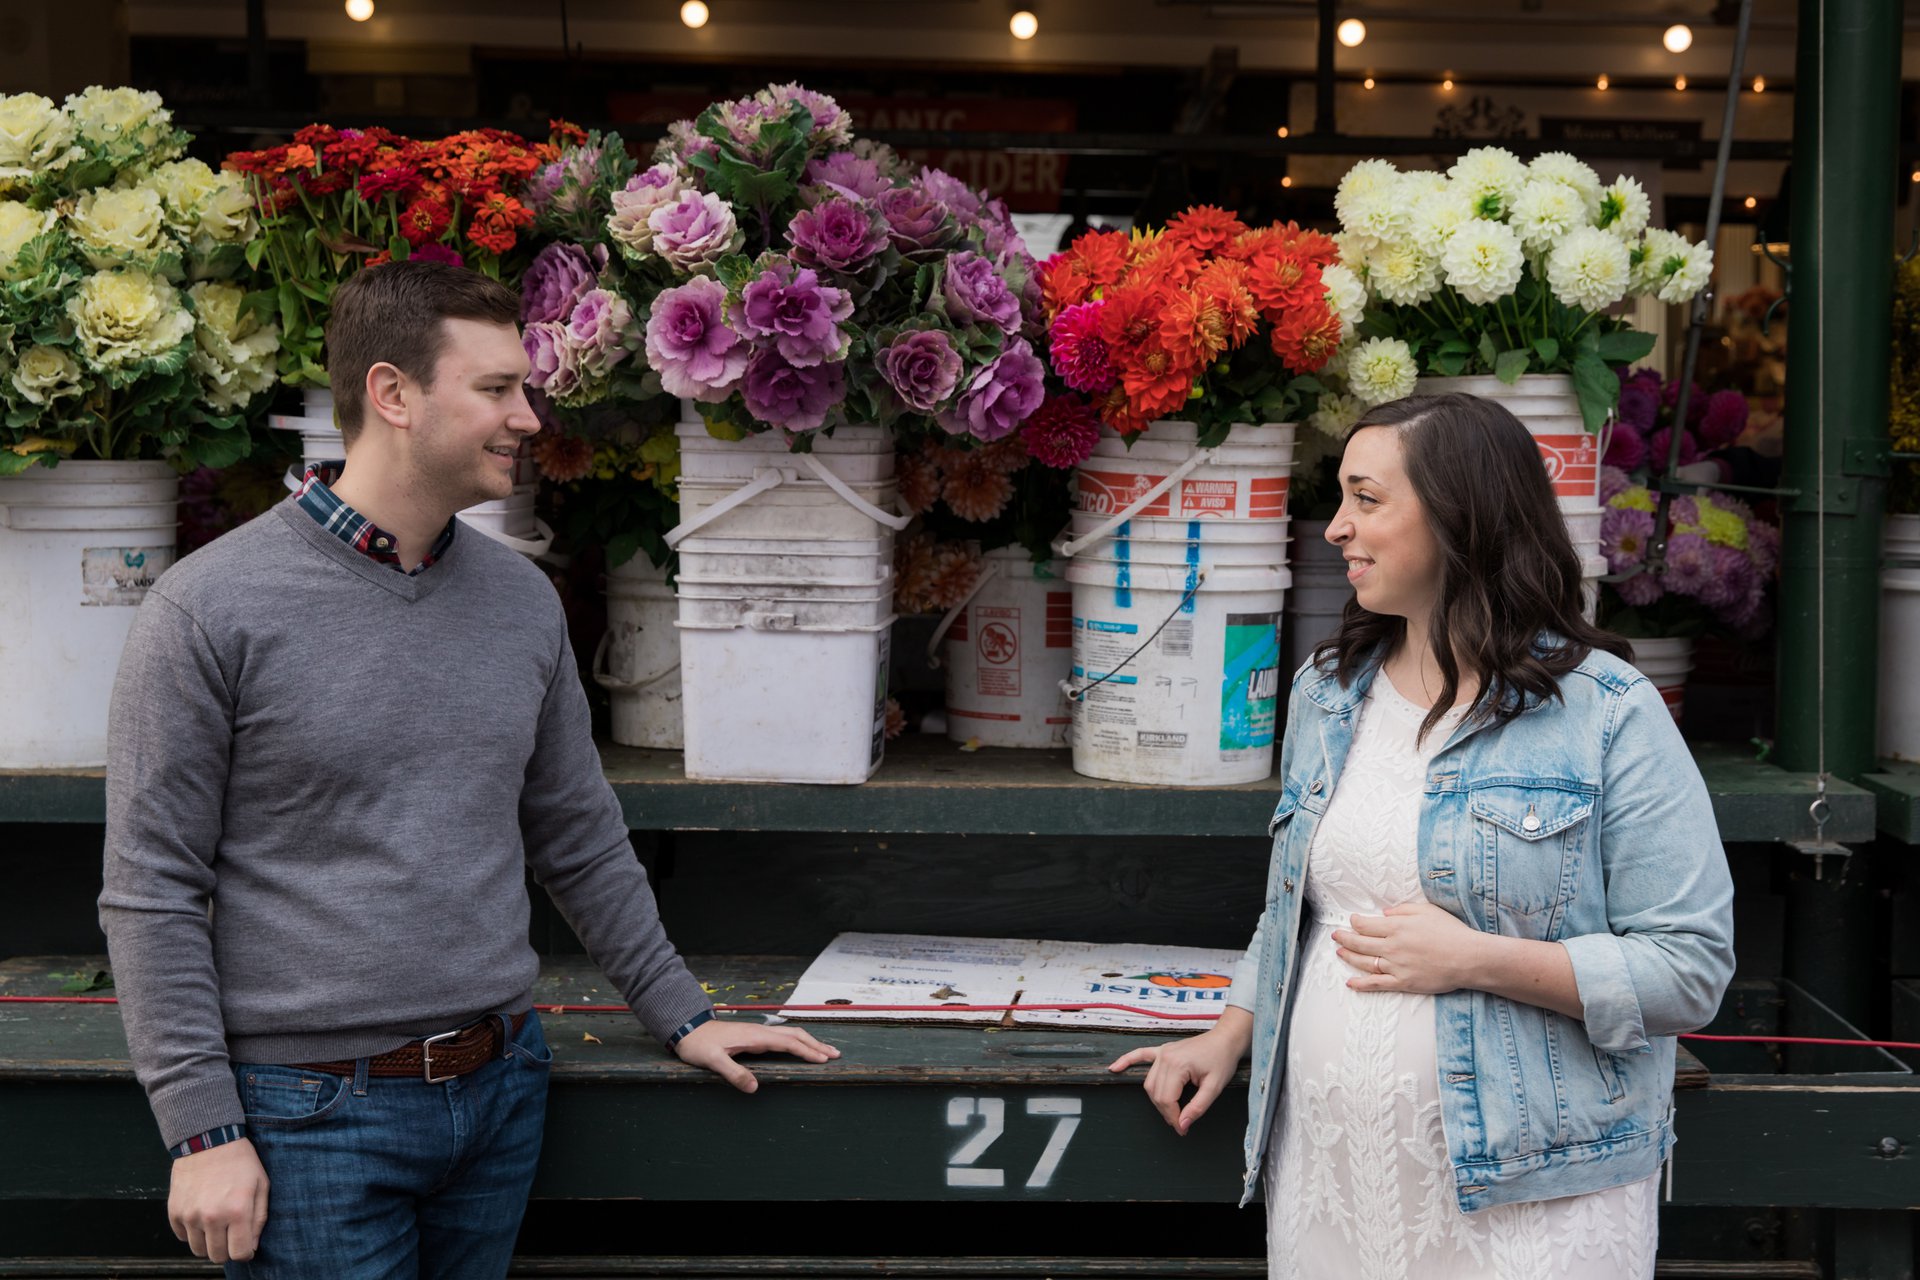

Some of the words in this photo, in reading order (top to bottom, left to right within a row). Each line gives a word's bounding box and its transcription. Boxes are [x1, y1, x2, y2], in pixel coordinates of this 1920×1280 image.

[1195, 482, 1236, 495] WARNING
[1199, 497, 1227, 509] AVISO
[1140, 733, 1186, 743] KIRKLAND
[946, 1096, 1083, 1188] 27
